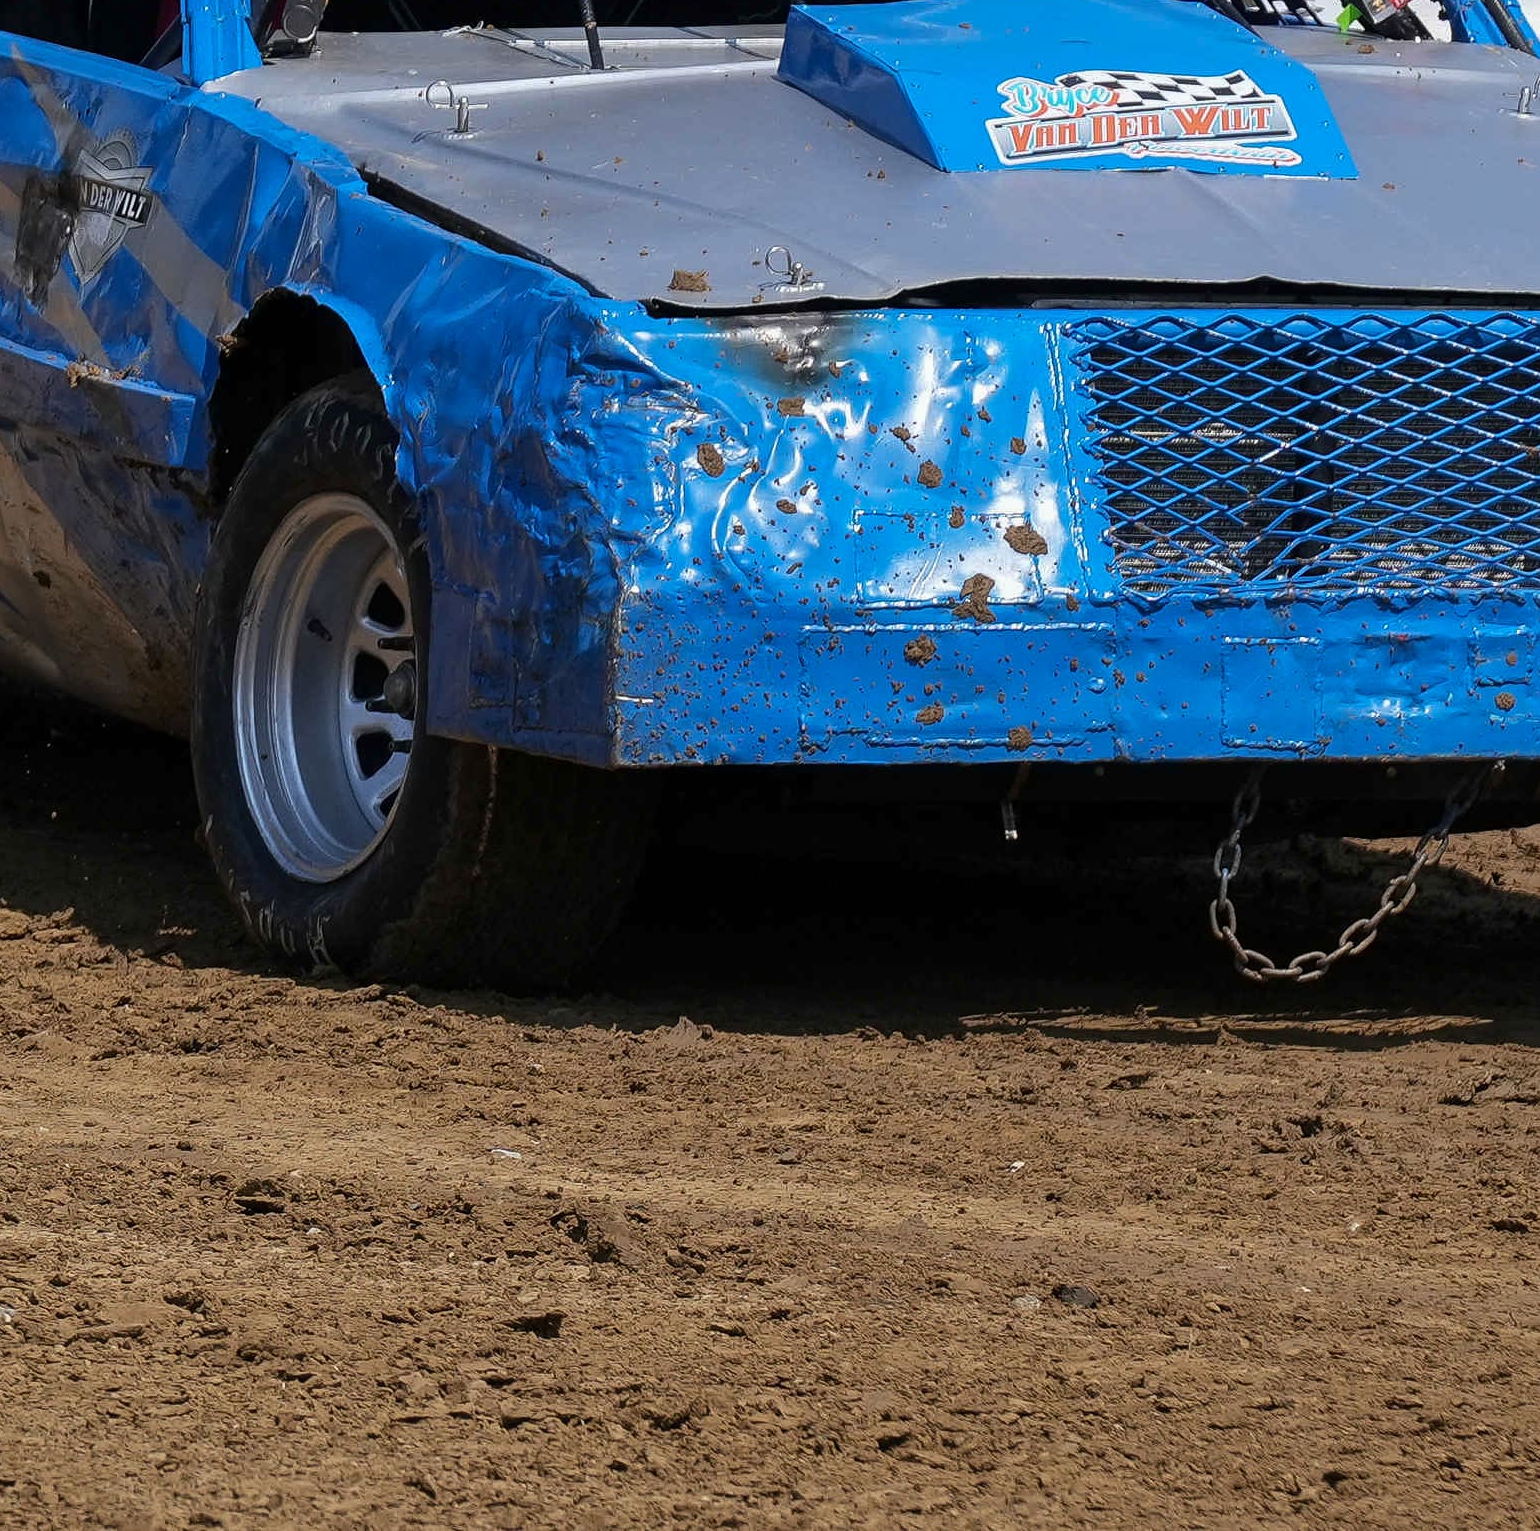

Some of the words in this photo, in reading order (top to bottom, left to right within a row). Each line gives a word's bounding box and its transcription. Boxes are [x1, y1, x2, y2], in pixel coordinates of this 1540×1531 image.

[1010, 81, 1116, 117] Bryce
[90, 180, 113, 209] DER
[115, 189, 147, 220] WILT
